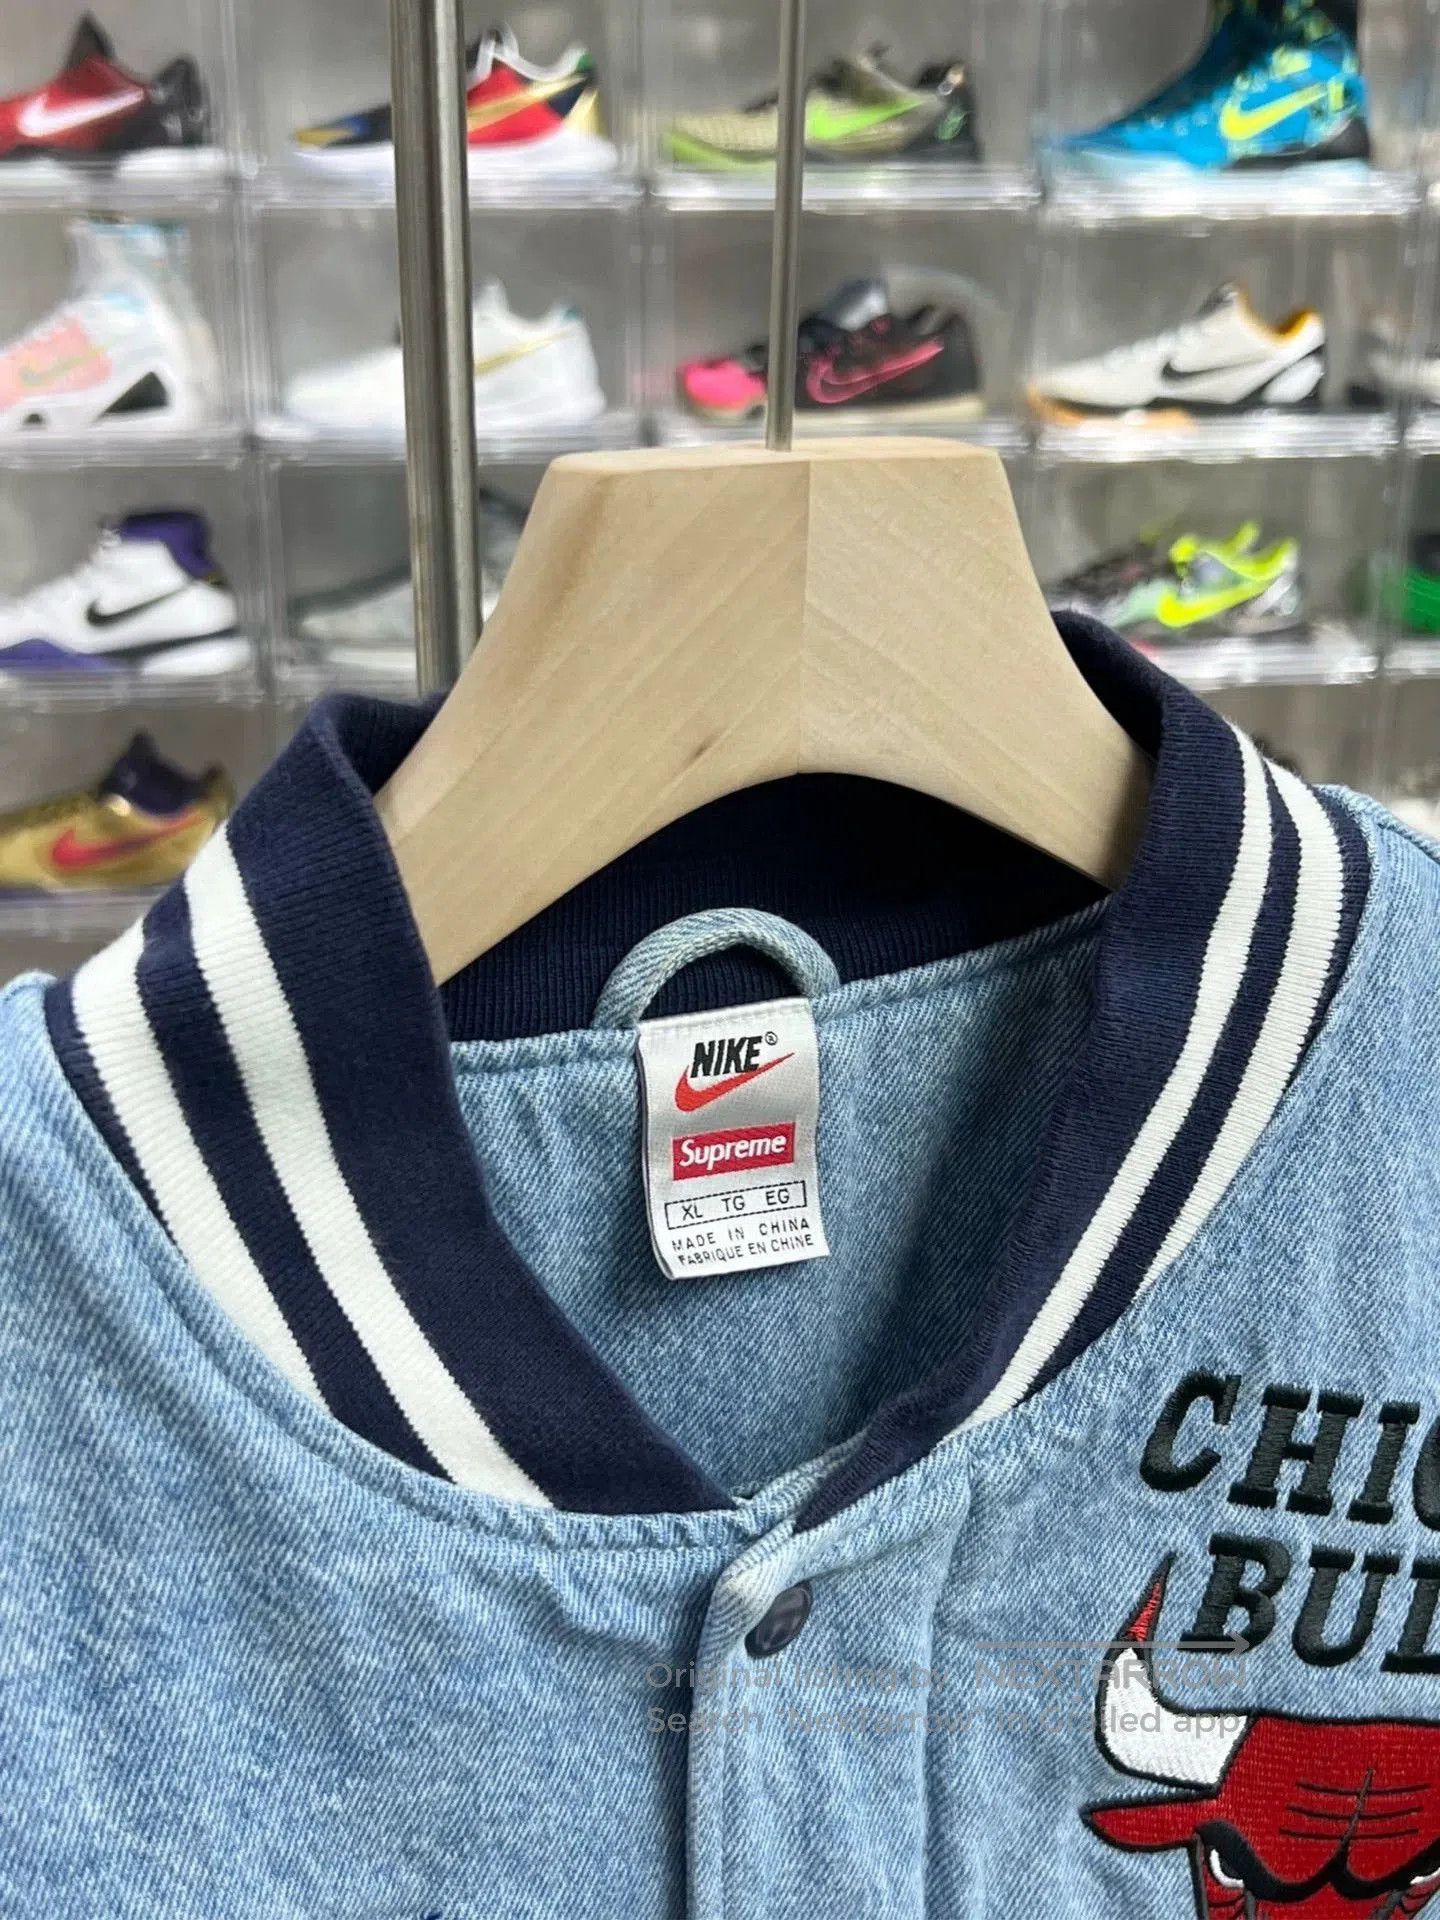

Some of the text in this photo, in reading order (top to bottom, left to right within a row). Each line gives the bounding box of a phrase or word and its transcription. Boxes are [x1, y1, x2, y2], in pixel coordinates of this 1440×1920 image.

[680, 1135, 787, 1171] Supreme
[681, 1188, 790, 1221] XL TG EG
[672, 1217, 810, 1252] MADE IN CHINA
[678, 1234, 814, 1266] FABRIQUE EN CHINE
[1140, 1367, 1440, 1531] CHI
